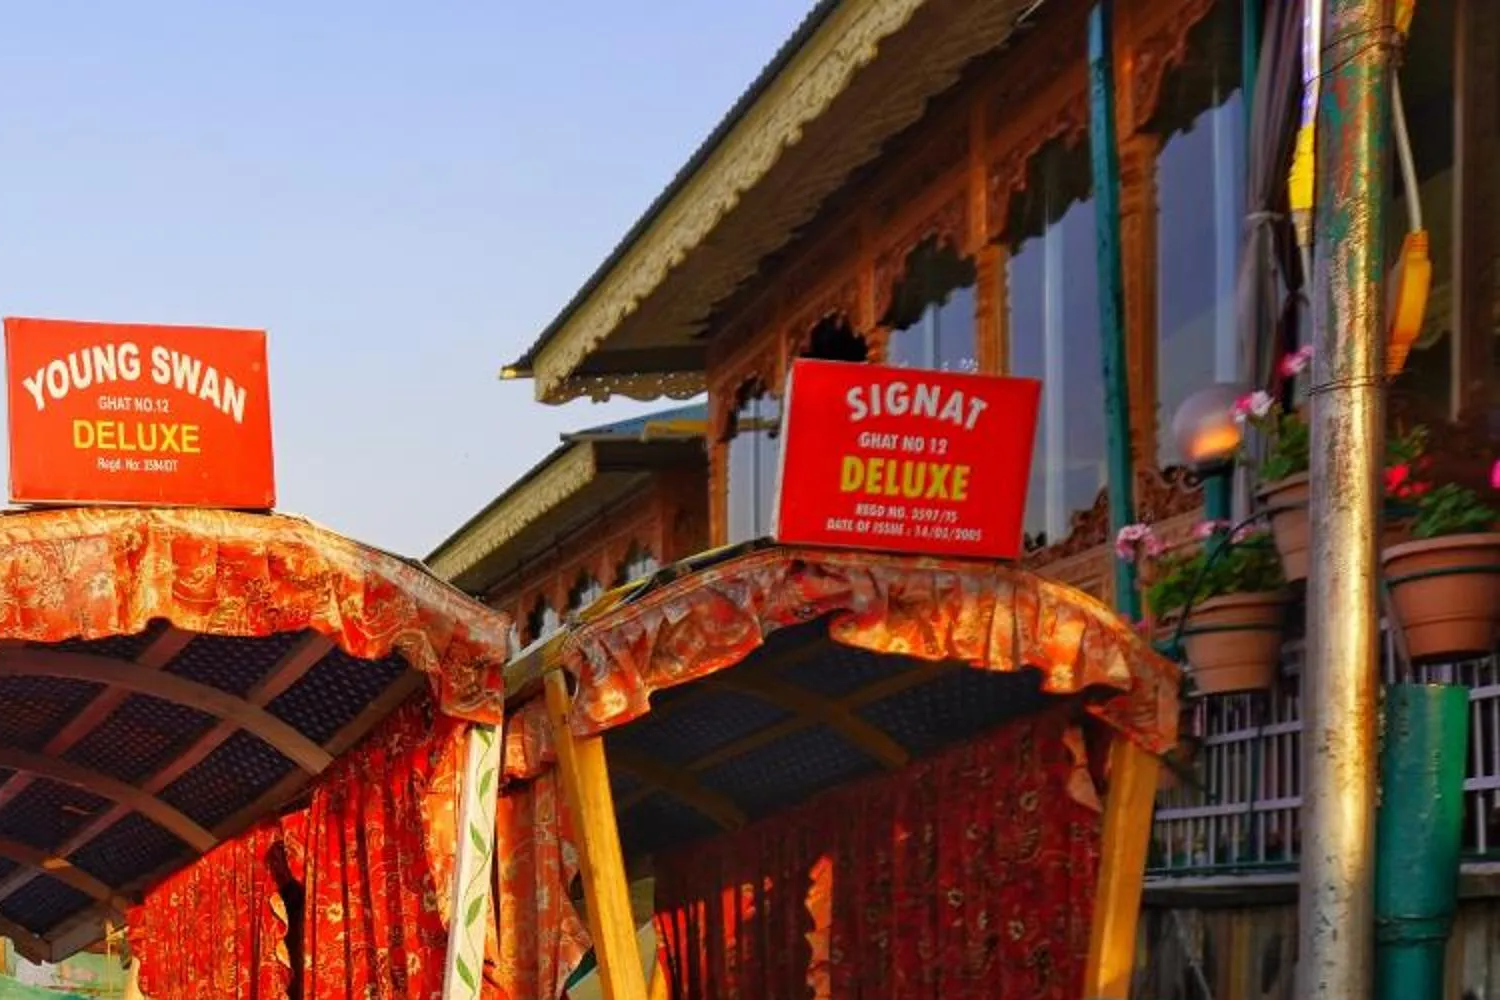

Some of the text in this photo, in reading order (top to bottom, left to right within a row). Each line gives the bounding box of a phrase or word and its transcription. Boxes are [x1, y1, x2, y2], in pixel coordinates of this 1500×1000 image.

[22, 341, 247, 424] YOUNG SWAN
[98, 394, 132, 411] GHAT
[846, 381, 988, 430] SIGNAT
[72, 418, 200, 453] DELUXE
[857, 431, 949, 455] GHAT NO 12
[839, 454, 971, 501] DELUXE
